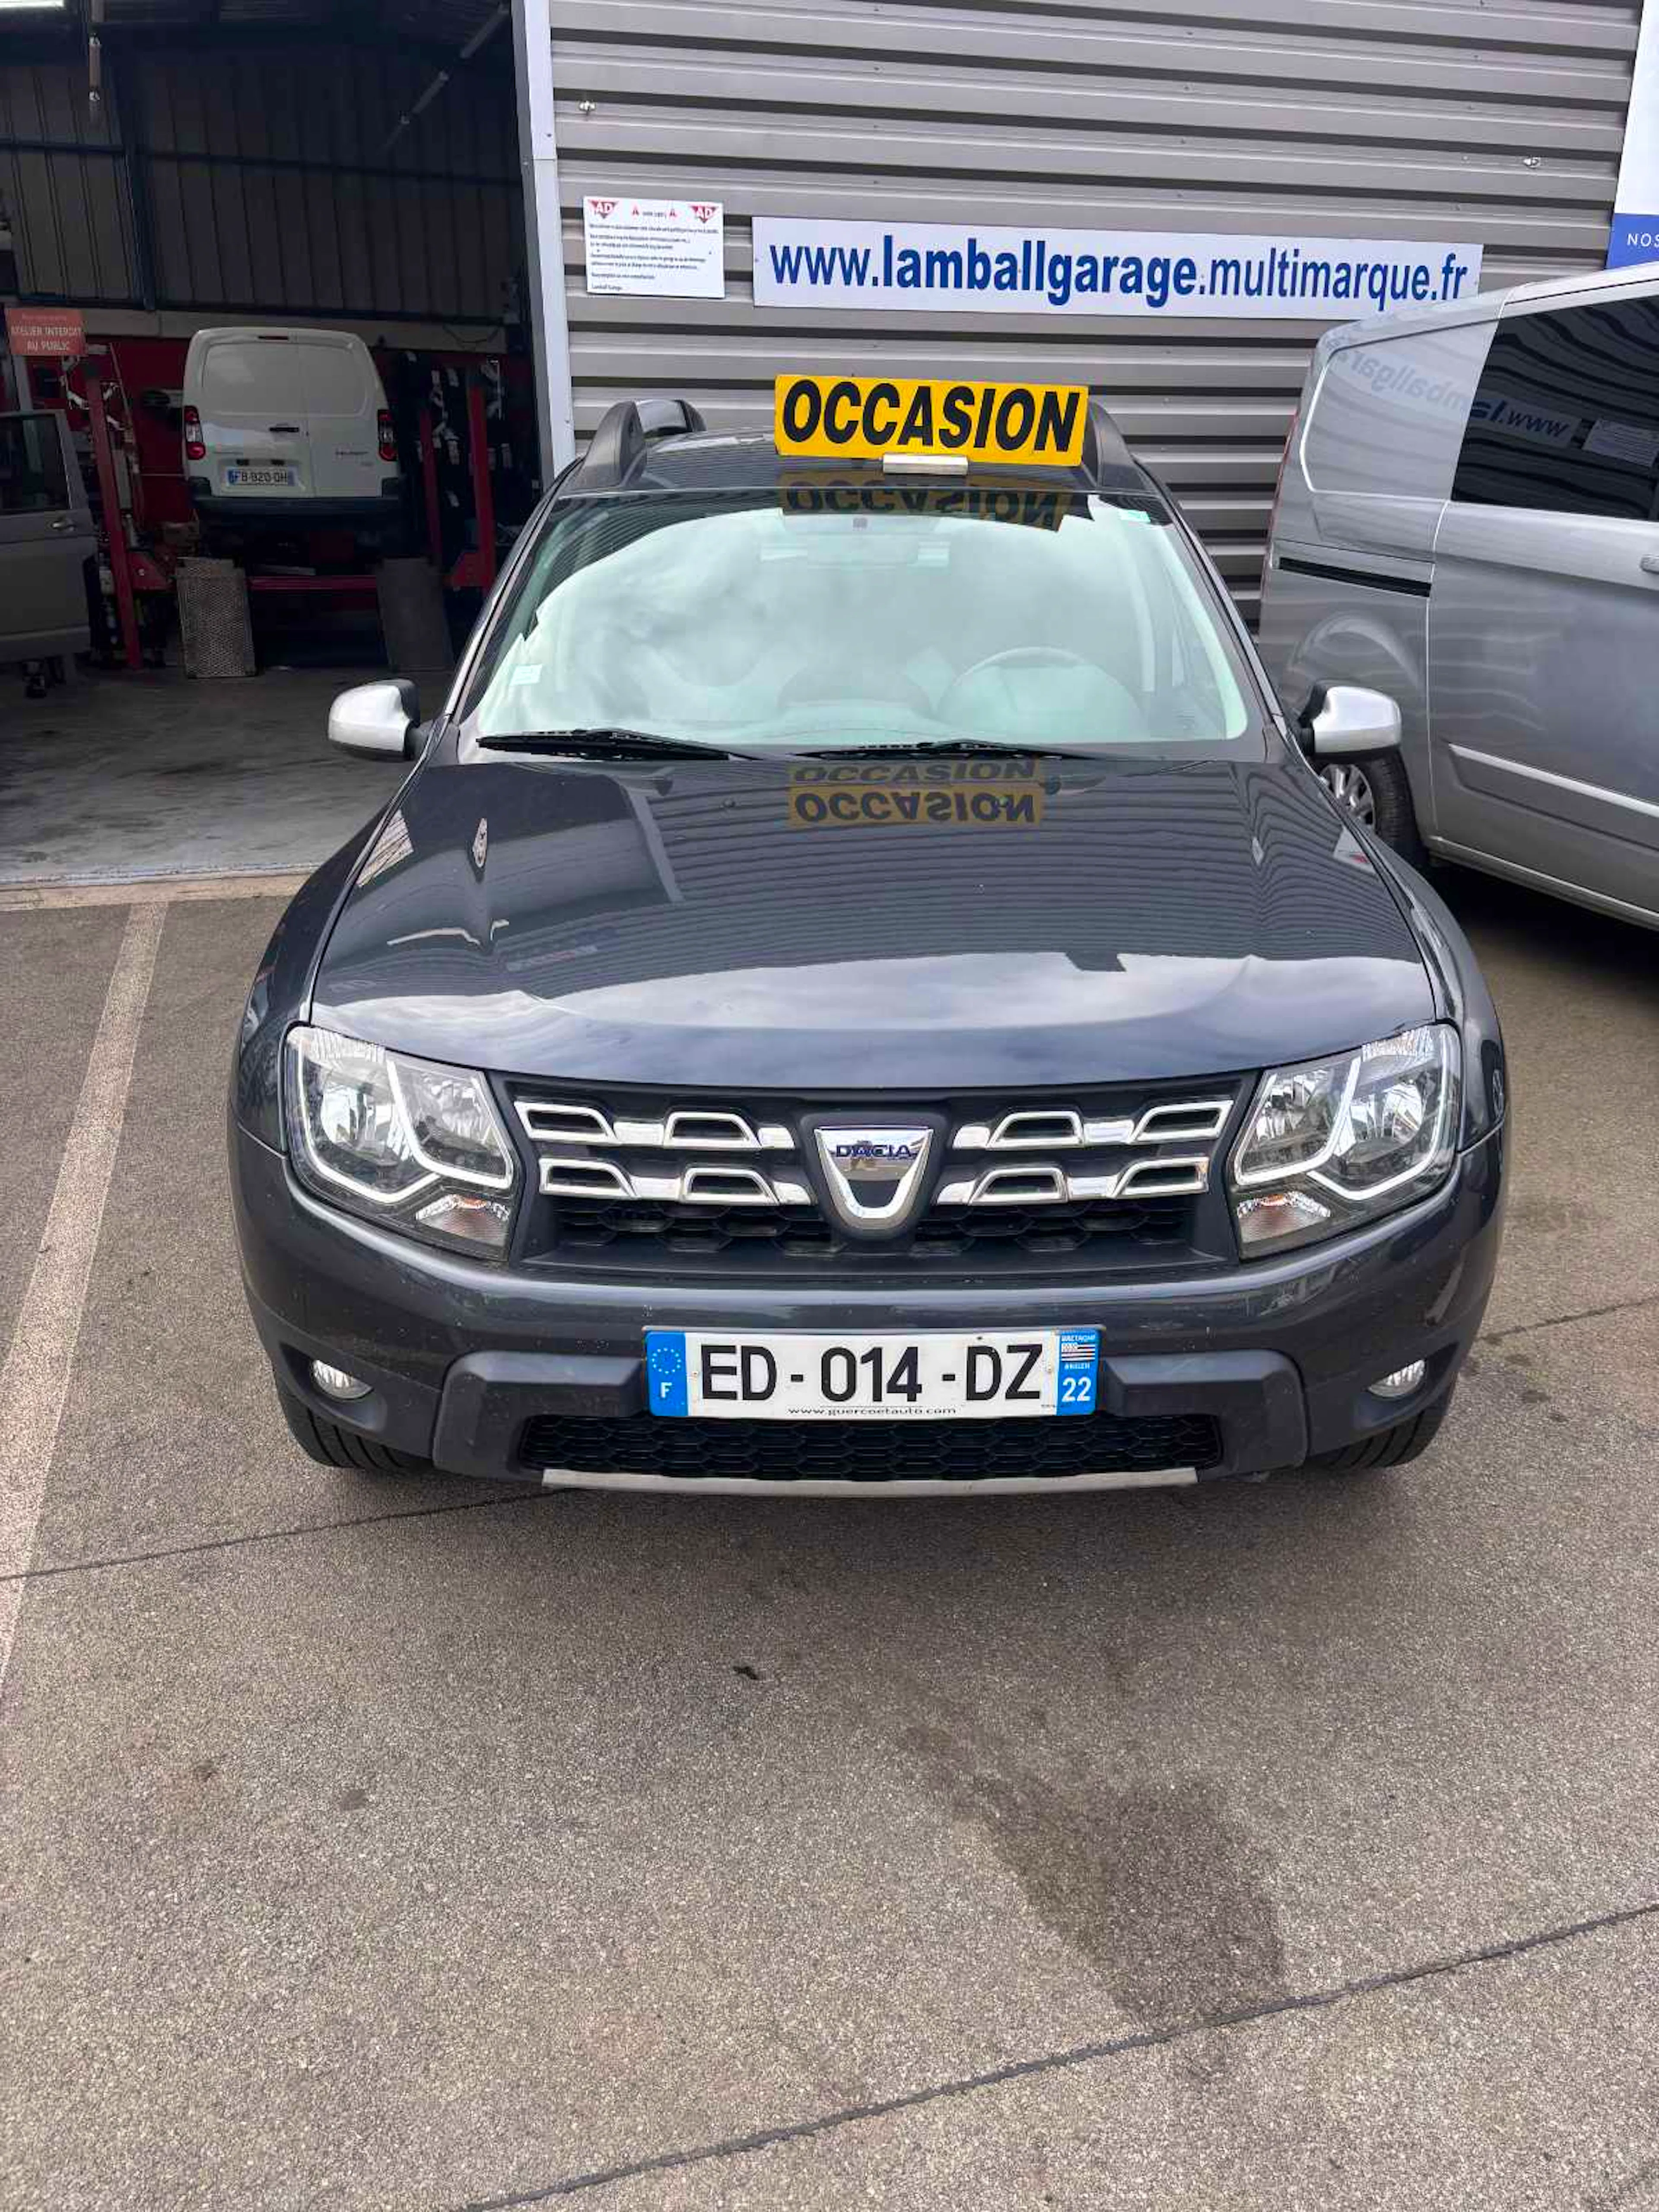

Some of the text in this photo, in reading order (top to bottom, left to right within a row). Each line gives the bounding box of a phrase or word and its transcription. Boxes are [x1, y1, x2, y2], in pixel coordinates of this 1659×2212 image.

[769, 235, 1468, 311] www.lamballgarage.multimarque.fr
[782, 379, 1080, 452] OCCASION
[836, 1144, 911, 1157] DACIA
[661, 1382, 671, 1398] F
[1061, 1376, 1091, 1402] 22
